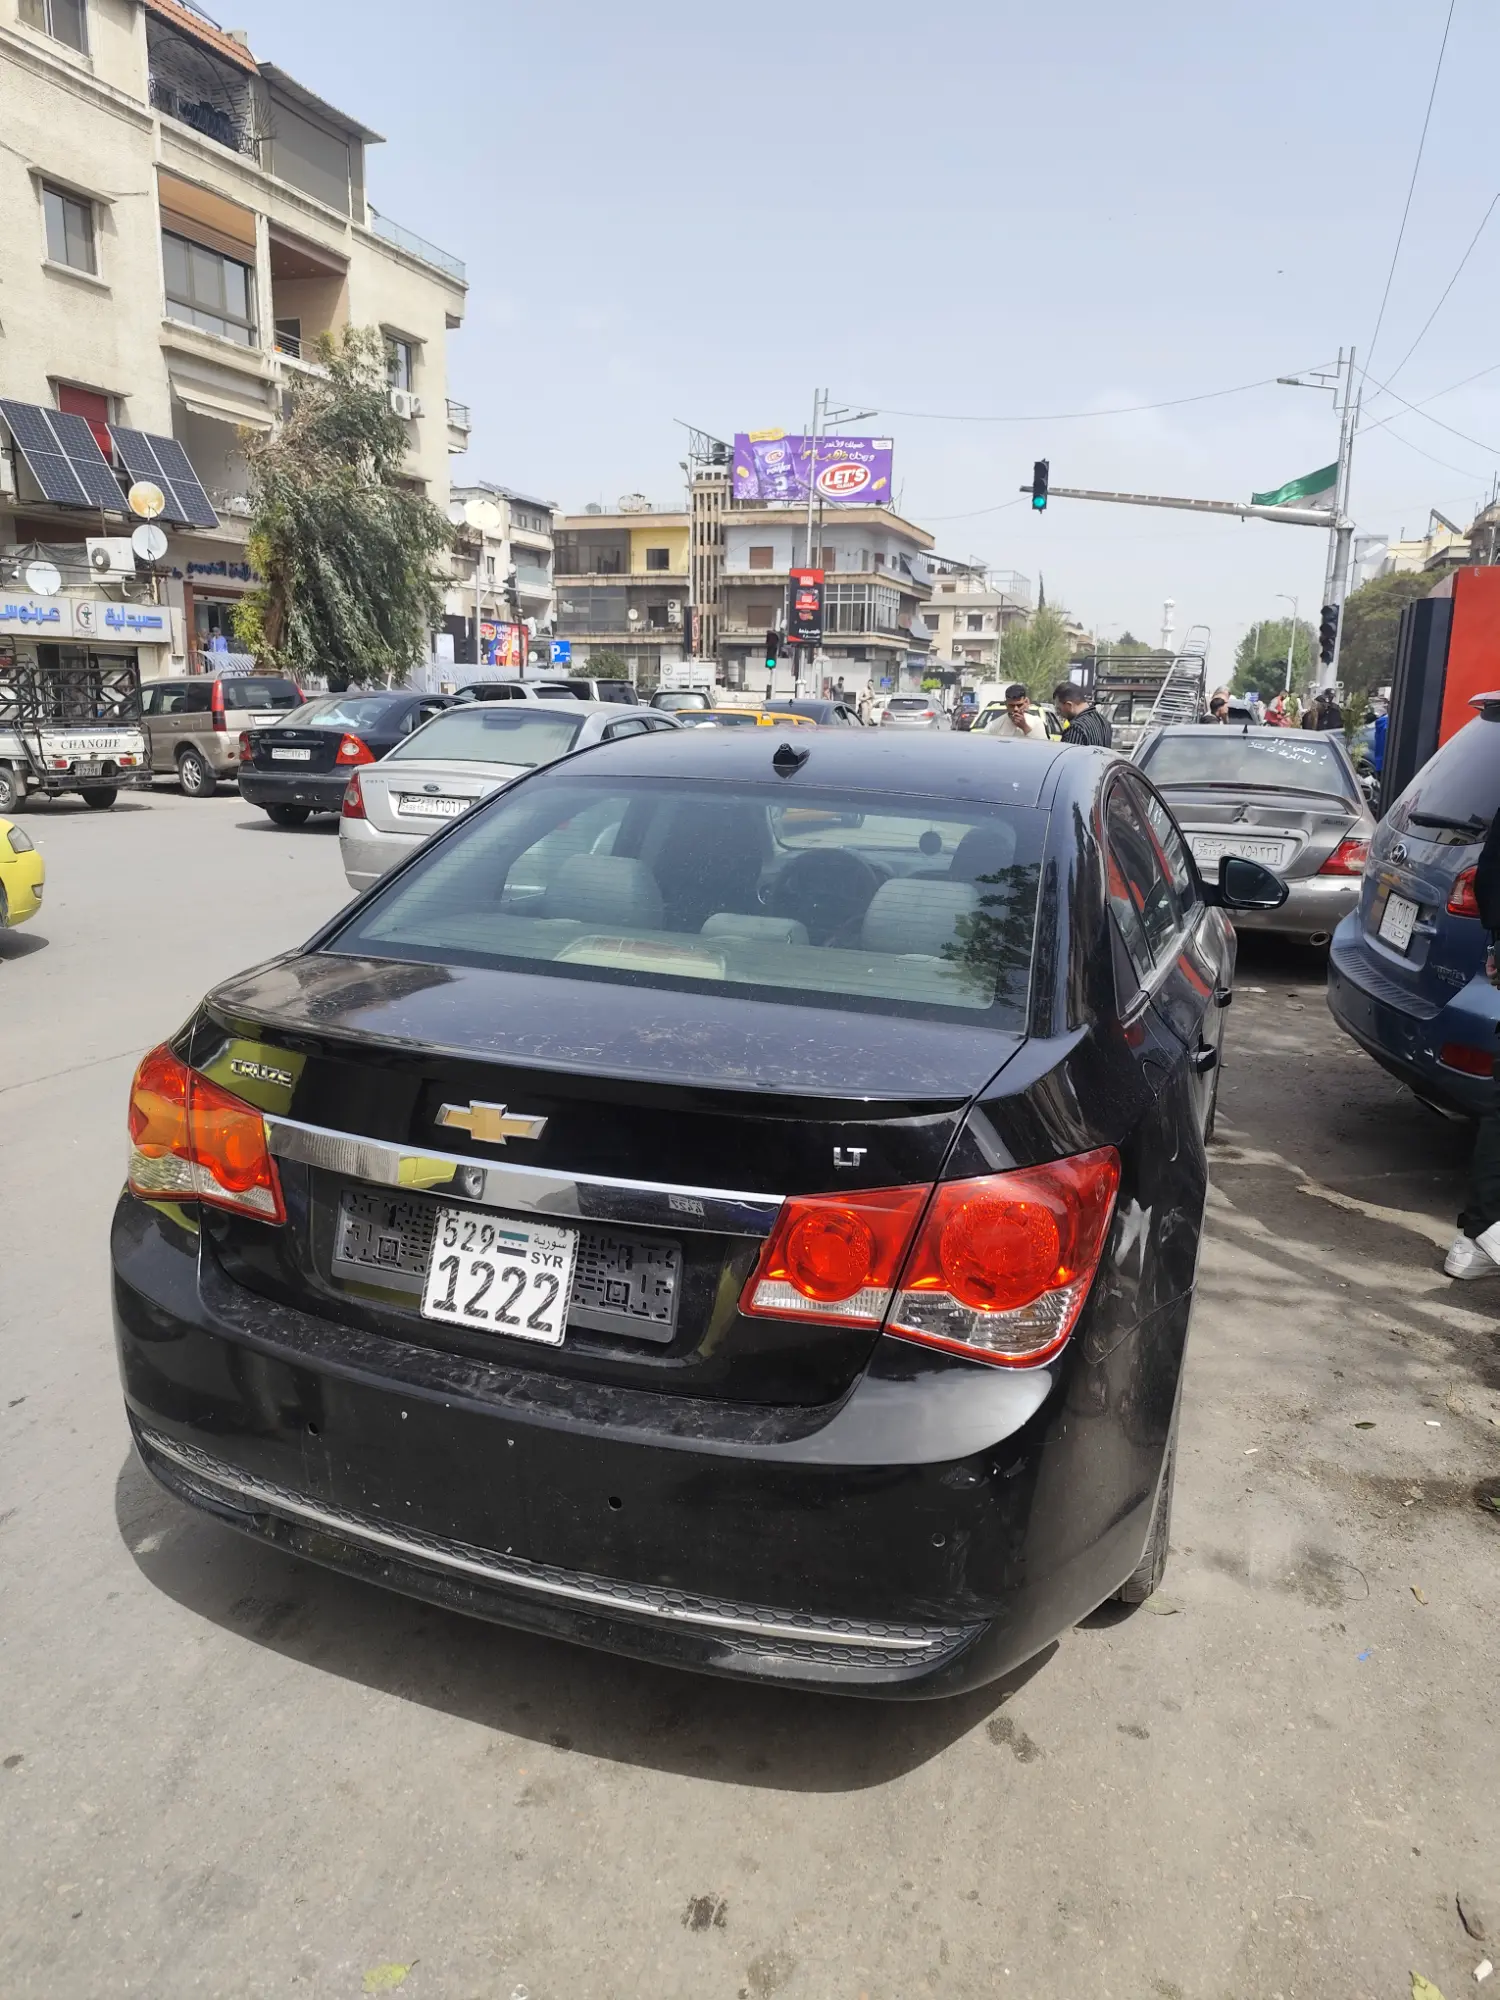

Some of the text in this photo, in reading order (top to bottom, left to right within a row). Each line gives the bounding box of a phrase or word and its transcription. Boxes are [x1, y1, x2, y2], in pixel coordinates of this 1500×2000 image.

[825, 468, 866, 486] LET'S
[105, 605, 162, 632] صيدلية
[550, 644, 561, 661] P
[61, 739, 121, 750] CHANGHE
[230, 1058, 292, 1088] CRUZE
[833, 1146, 868, 1167] LT
[443, 1217, 496, 1255] 529
[533, 1232, 567, 1251] سورية
[531, 1252, 564, 1269] SYR
[432, 1255, 560, 1333] 1222
